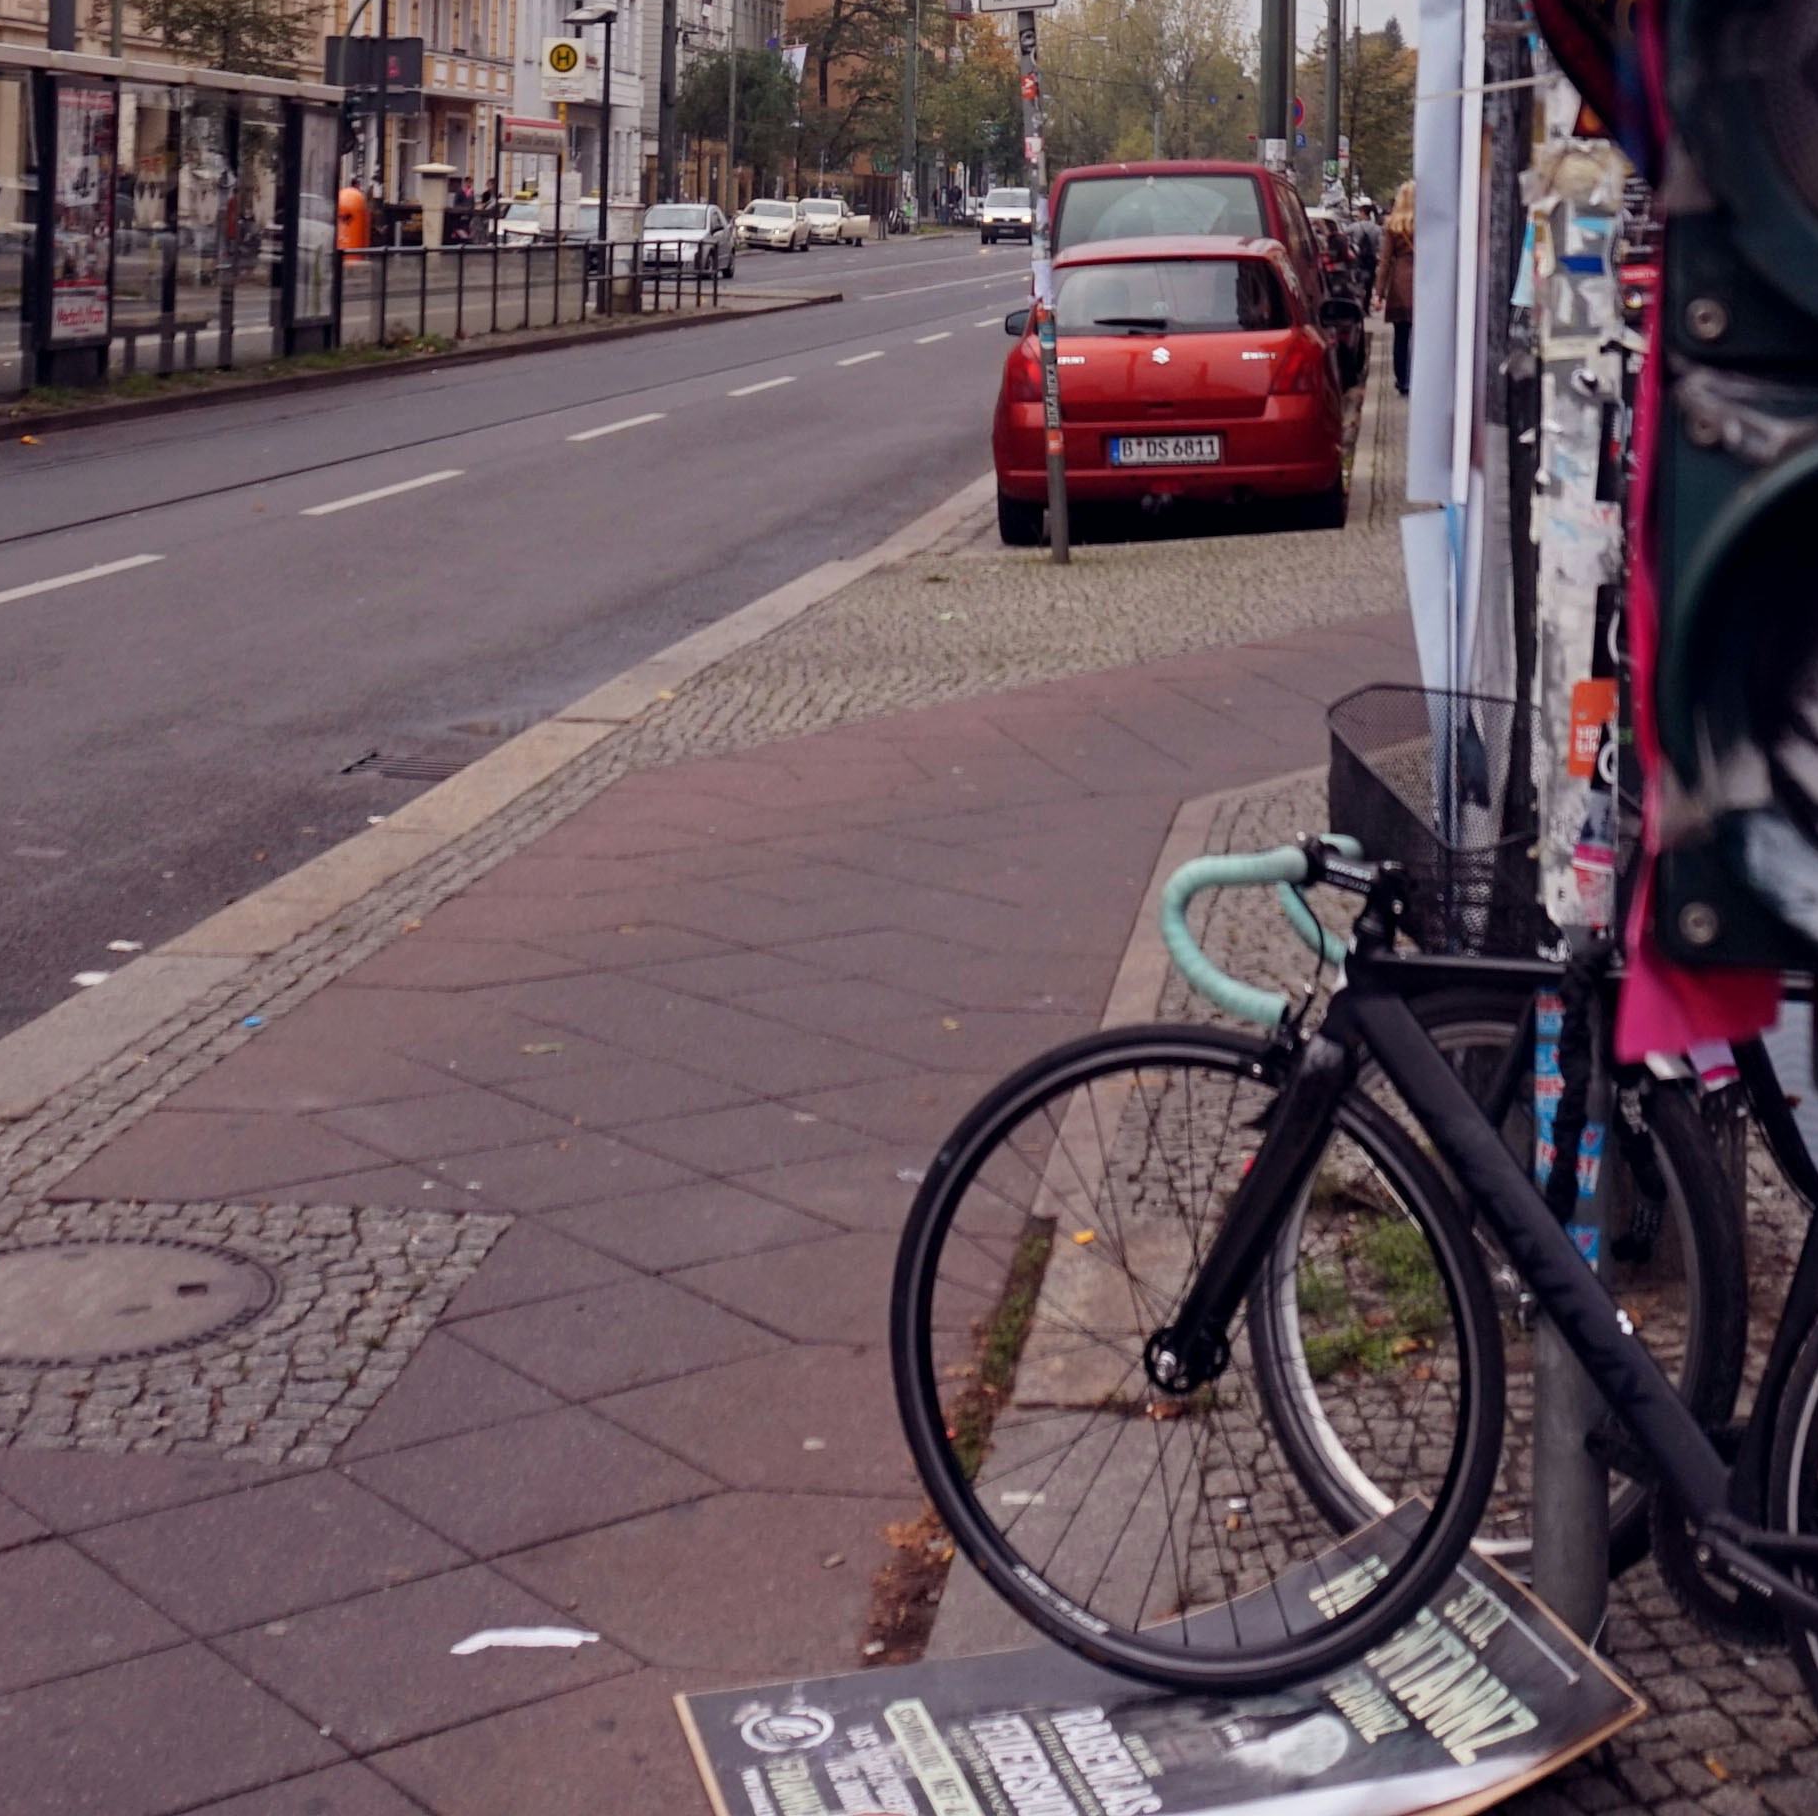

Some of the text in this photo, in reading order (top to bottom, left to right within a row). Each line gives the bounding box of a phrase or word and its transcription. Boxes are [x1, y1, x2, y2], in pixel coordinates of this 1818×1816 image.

[1122, 439, 1217, 457] B DS 6811
